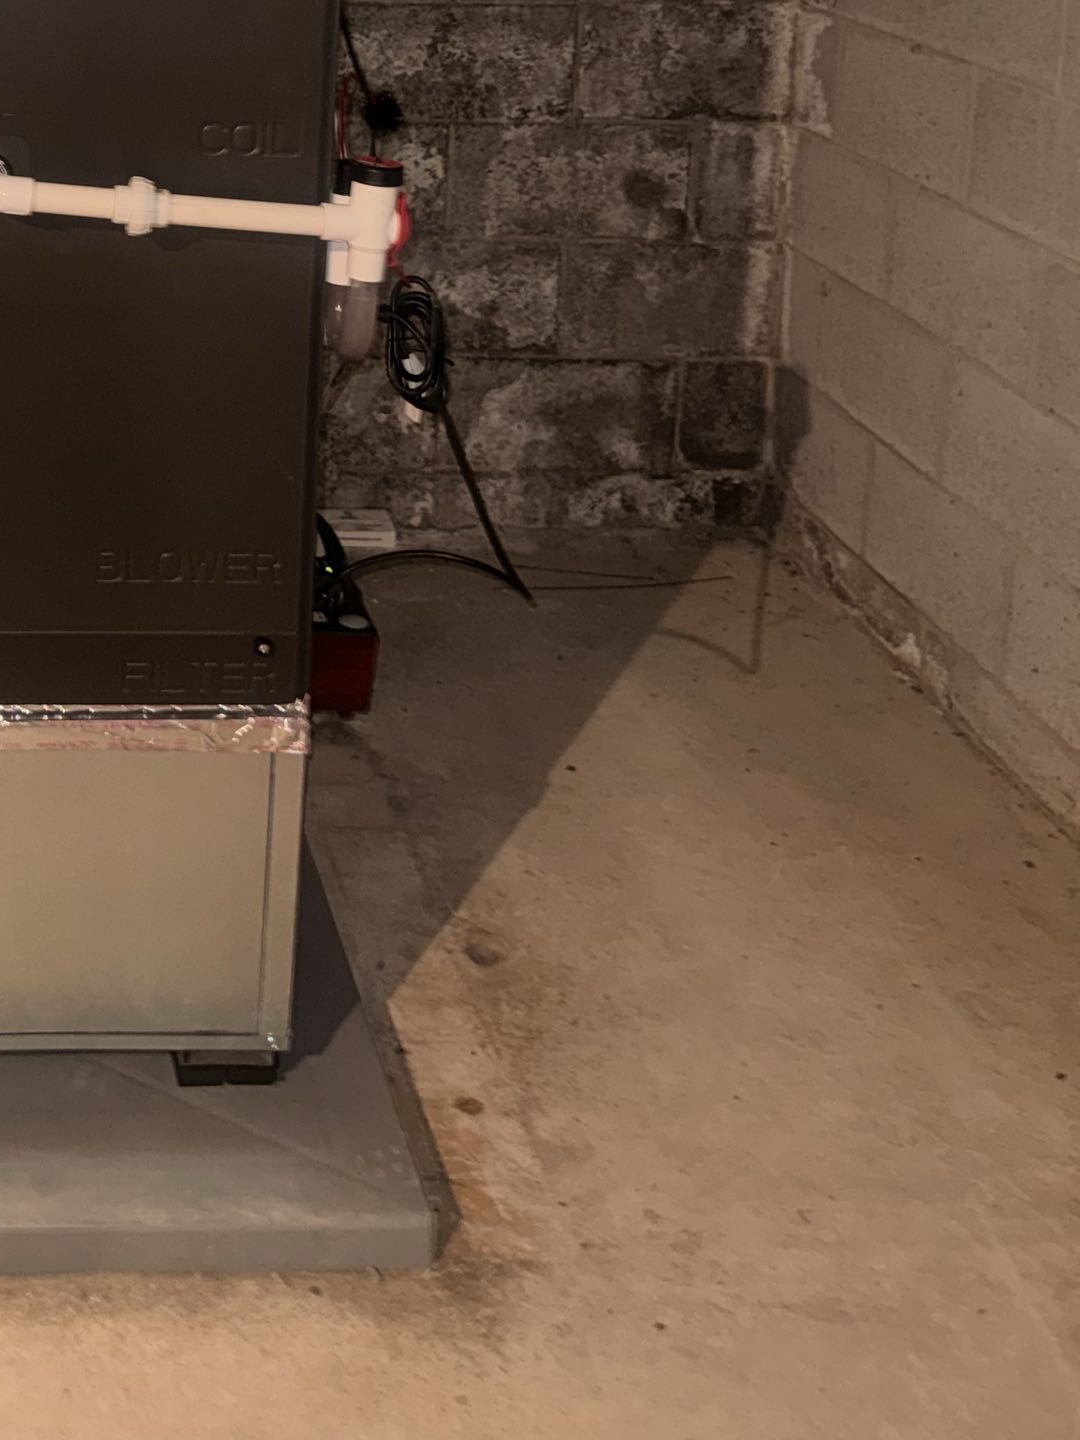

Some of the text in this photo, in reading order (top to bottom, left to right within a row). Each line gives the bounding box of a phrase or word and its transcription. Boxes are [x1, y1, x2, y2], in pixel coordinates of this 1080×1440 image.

[196, 120, 301, 158] COIL
[95, 552, 282, 584] BLOWER
[122, 662, 276, 693] FILTER
